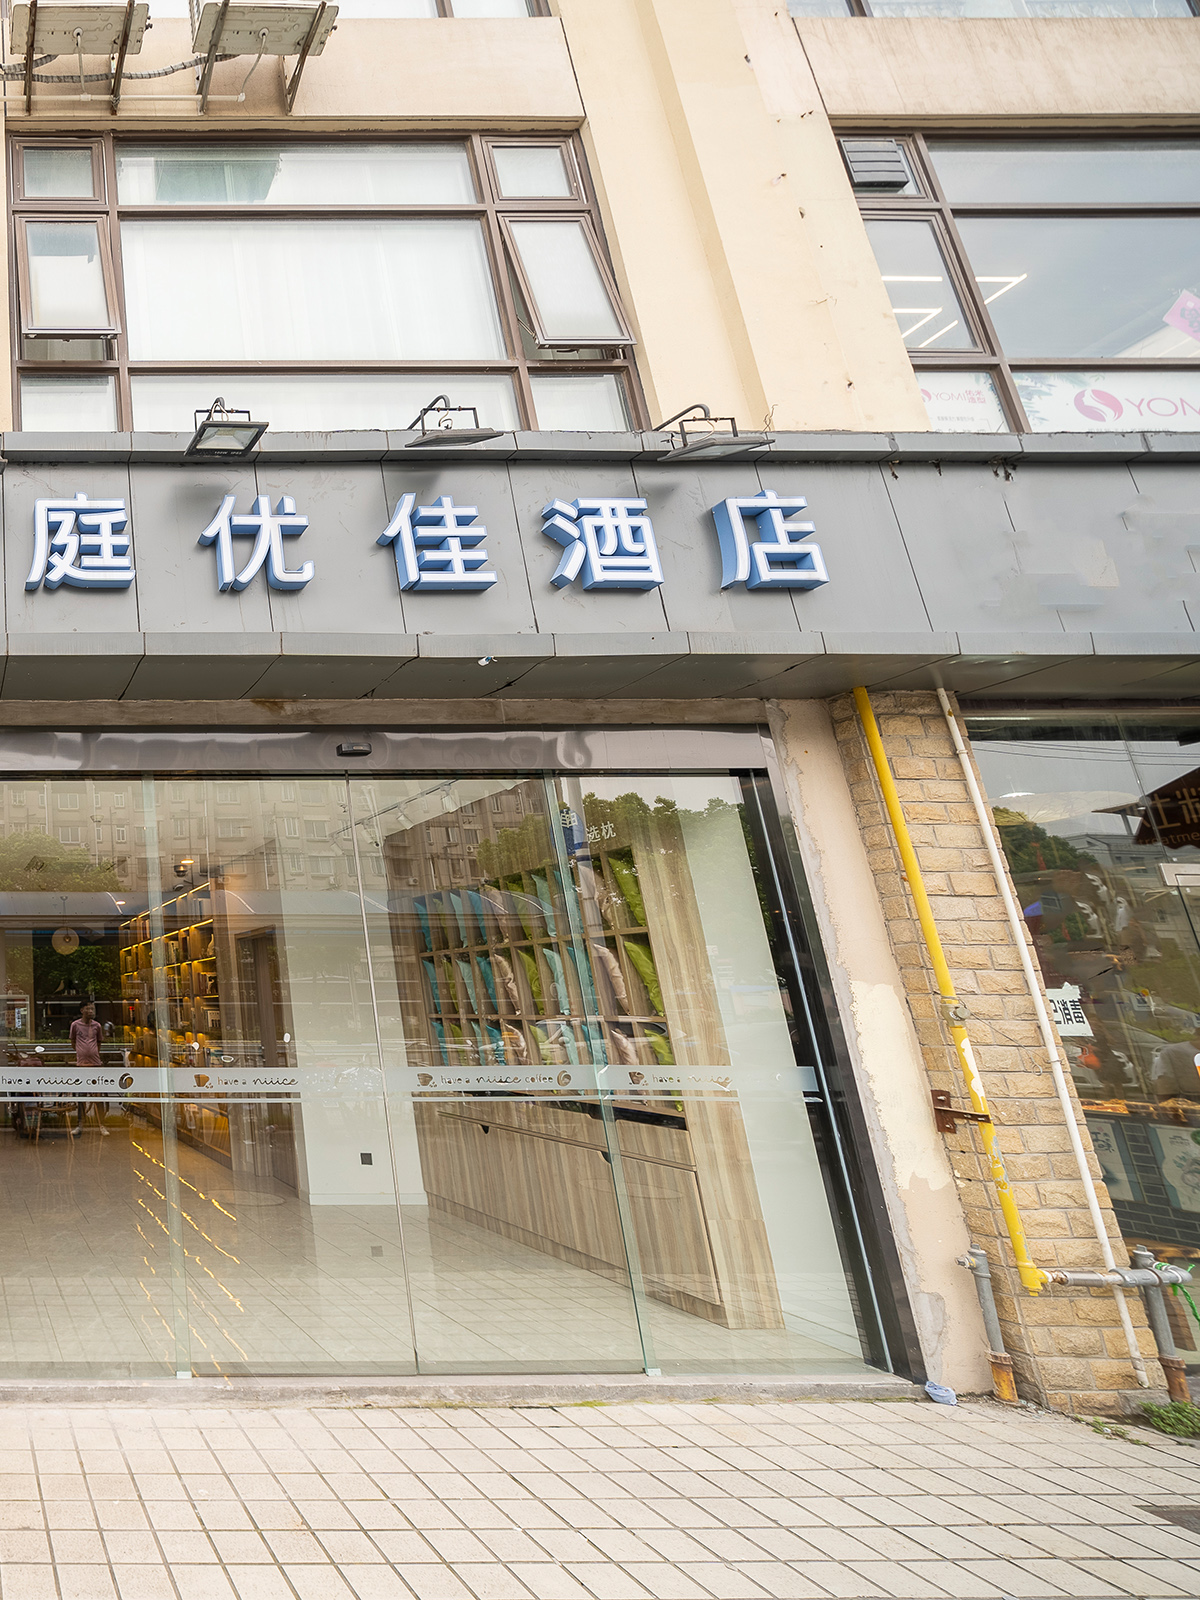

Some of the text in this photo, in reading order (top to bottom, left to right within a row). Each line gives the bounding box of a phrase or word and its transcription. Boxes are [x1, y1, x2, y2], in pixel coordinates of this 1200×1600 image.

[932, 391, 967, 402] YOMI
[2, 1076, 22, 1085] have
[86, 1076, 115, 1085] coffee
[218, 1077, 239, 1085] have
[441, 1075, 462, 1084] have
[525, 1074, 553, 1084] coffee
[652, 1074, 674, 1083] have
